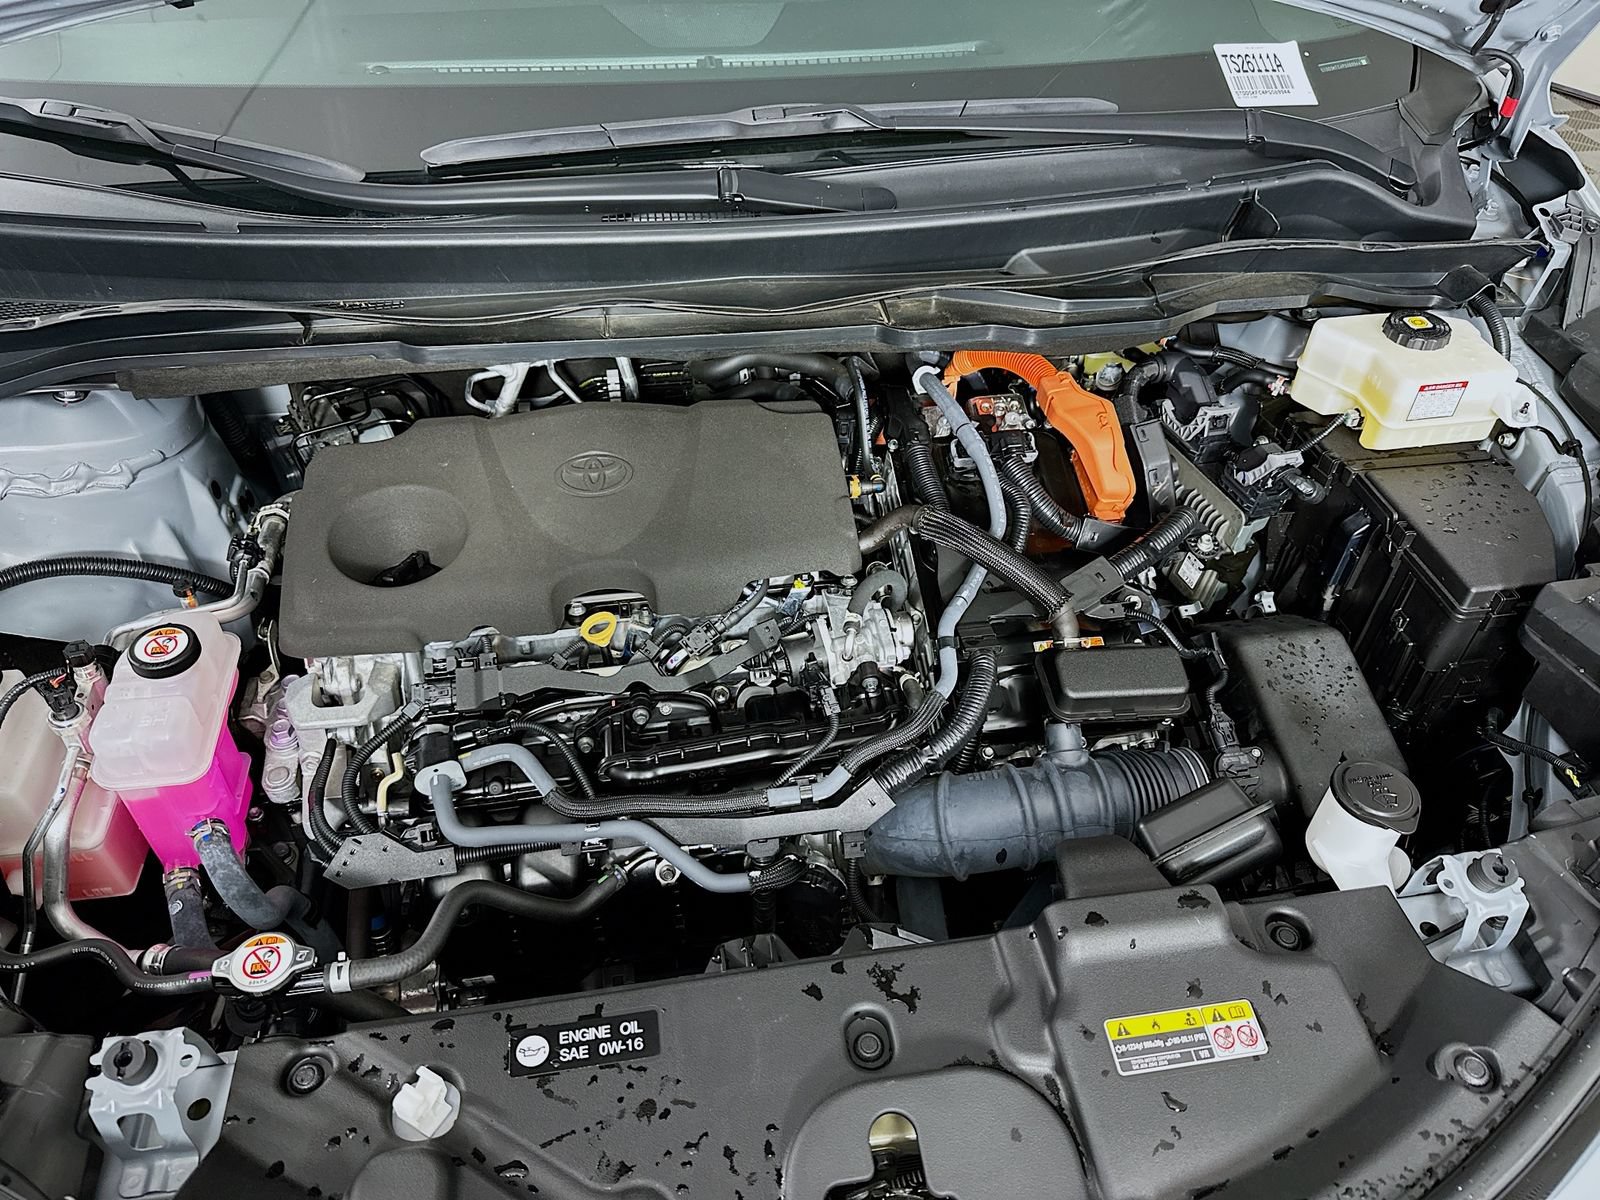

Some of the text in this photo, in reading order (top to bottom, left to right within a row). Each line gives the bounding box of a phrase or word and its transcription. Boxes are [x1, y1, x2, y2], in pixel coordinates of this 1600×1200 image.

[1221, 53, 1285, 74] TS26111A
[559, 1020, 643, 1045] ENGINE OIL
[559, 1037, 644, 1062] SAE 0W-16
